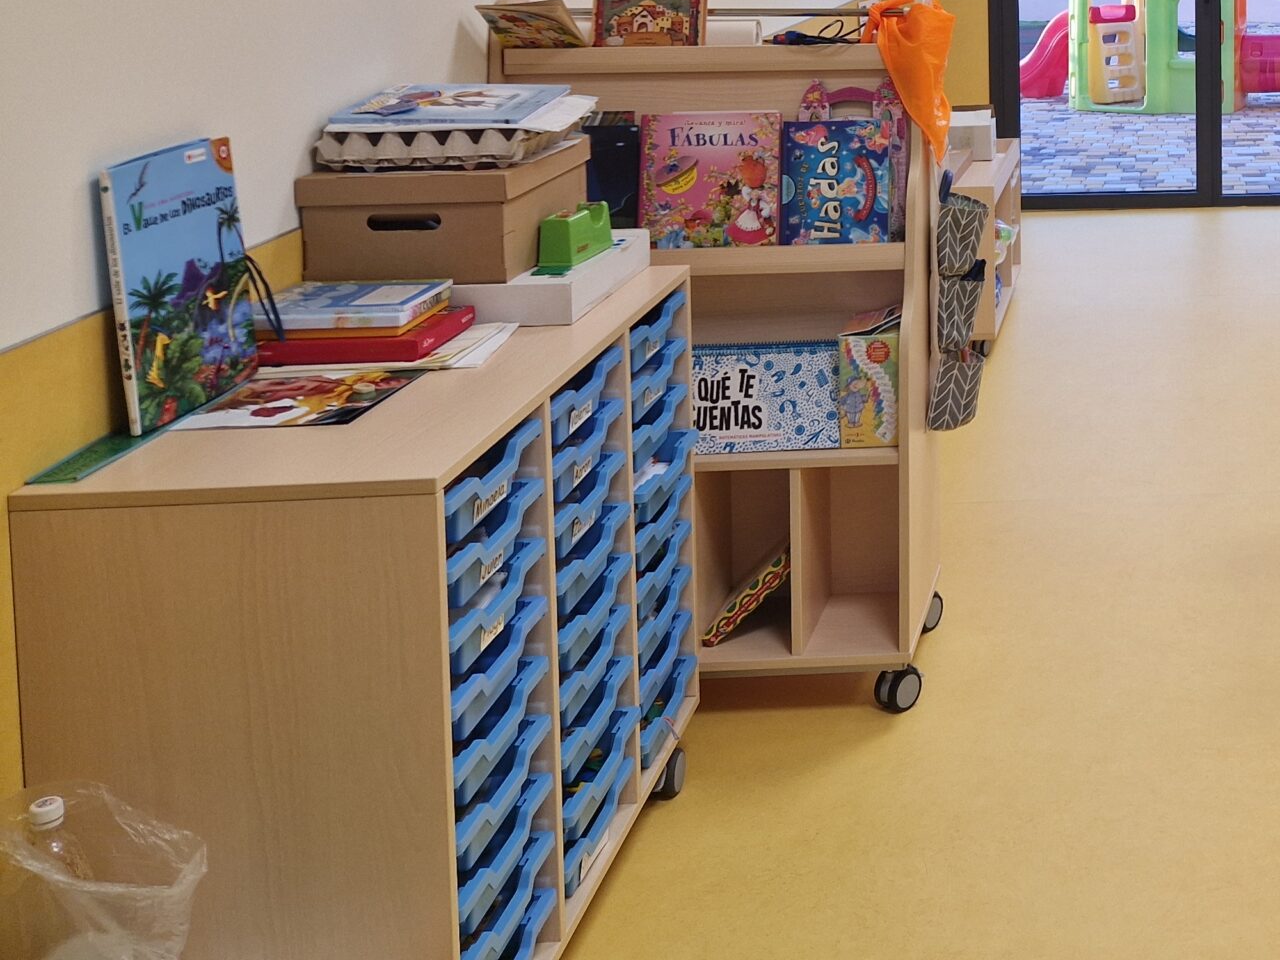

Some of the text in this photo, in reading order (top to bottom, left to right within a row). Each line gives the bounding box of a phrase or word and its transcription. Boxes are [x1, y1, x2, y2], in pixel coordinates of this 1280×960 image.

[667, 126, 759, 147] FÁBULAS
[810, 135, 841, 239] Hadas
[698, 368, 756, 404] QUÉ TE
[692, 400, 763, 431] UENTAS
